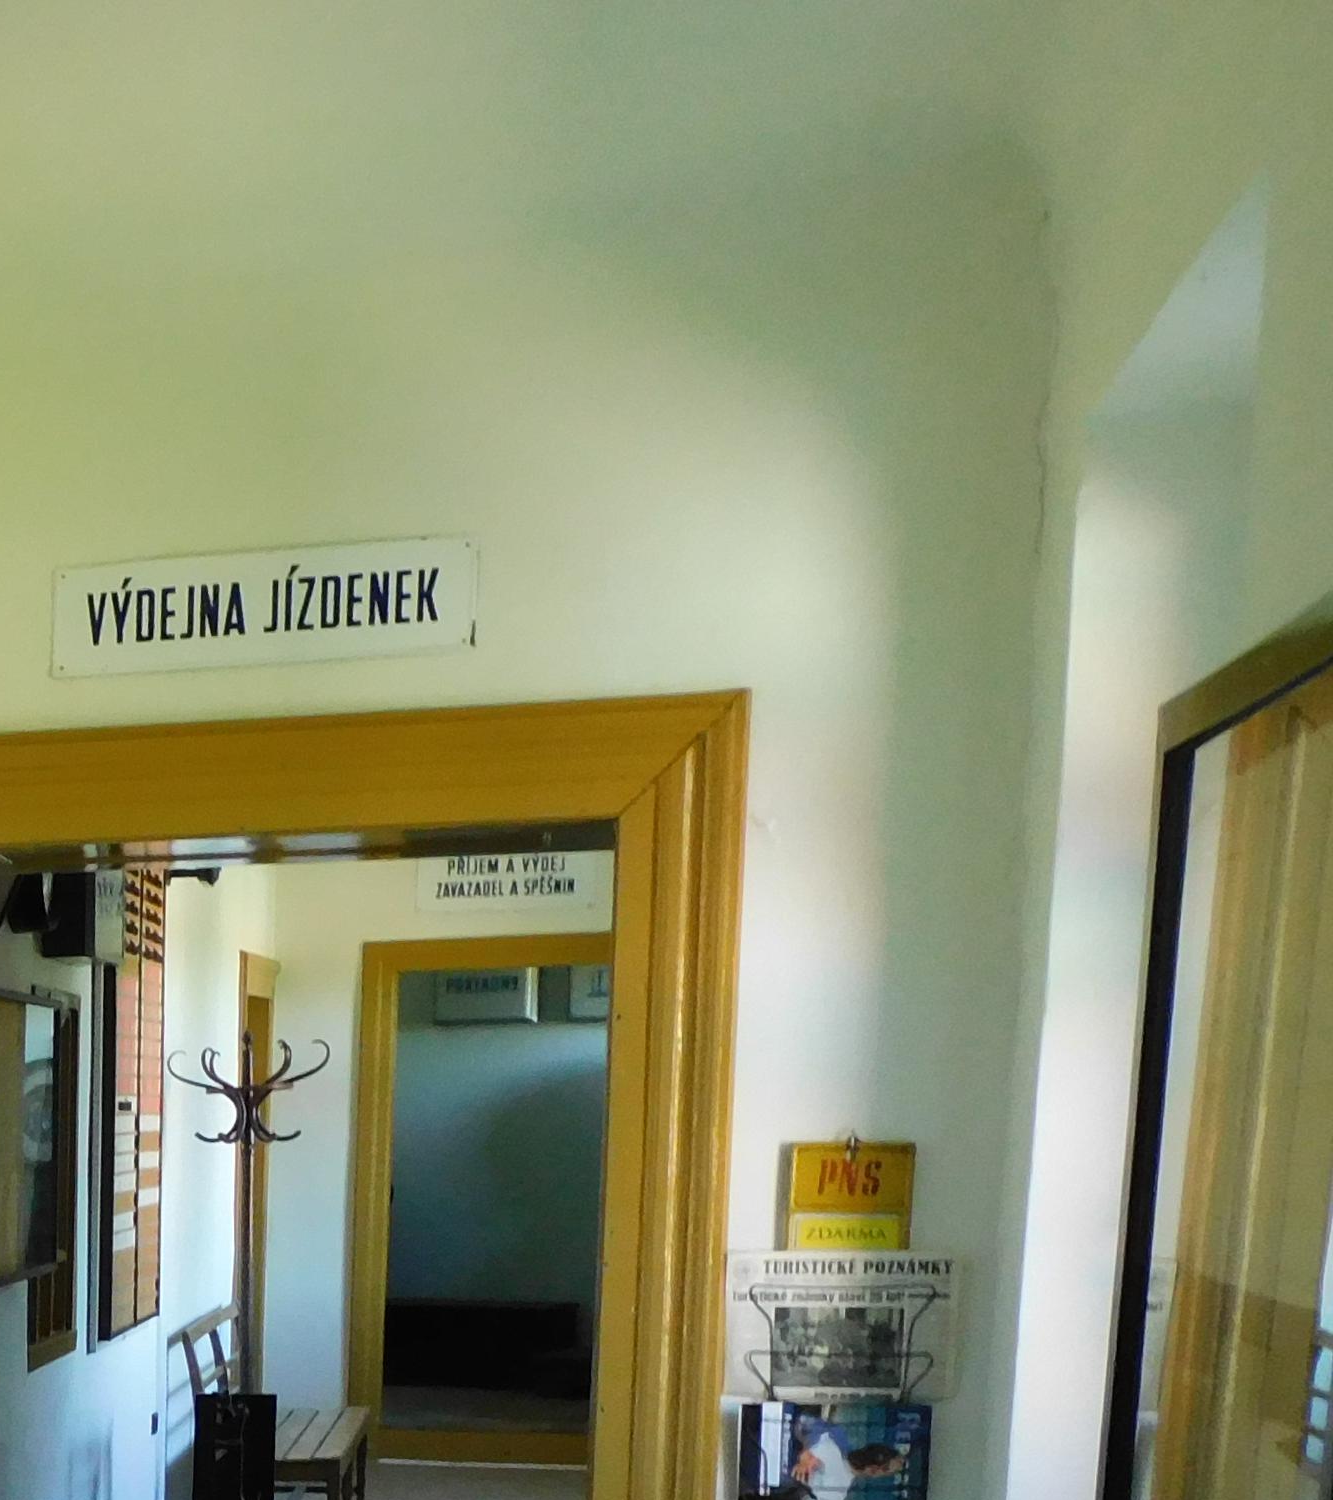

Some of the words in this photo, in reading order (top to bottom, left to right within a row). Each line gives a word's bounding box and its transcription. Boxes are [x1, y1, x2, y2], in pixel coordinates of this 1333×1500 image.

[87, 577, 246, 646] VÝDEJNA
[263, 564, 439, 633] JÍZDENEK
[446, 856, 499, 876] PŘÍJEM
[506, 858, 514, 873] A
[435, 880, 504, 899] ZAVAZADEL
[509, 881, 518, 896] A
[817, 1158, 882, 1197] PNS
[863, 1258, 953, 1275] POZNÁMKY
